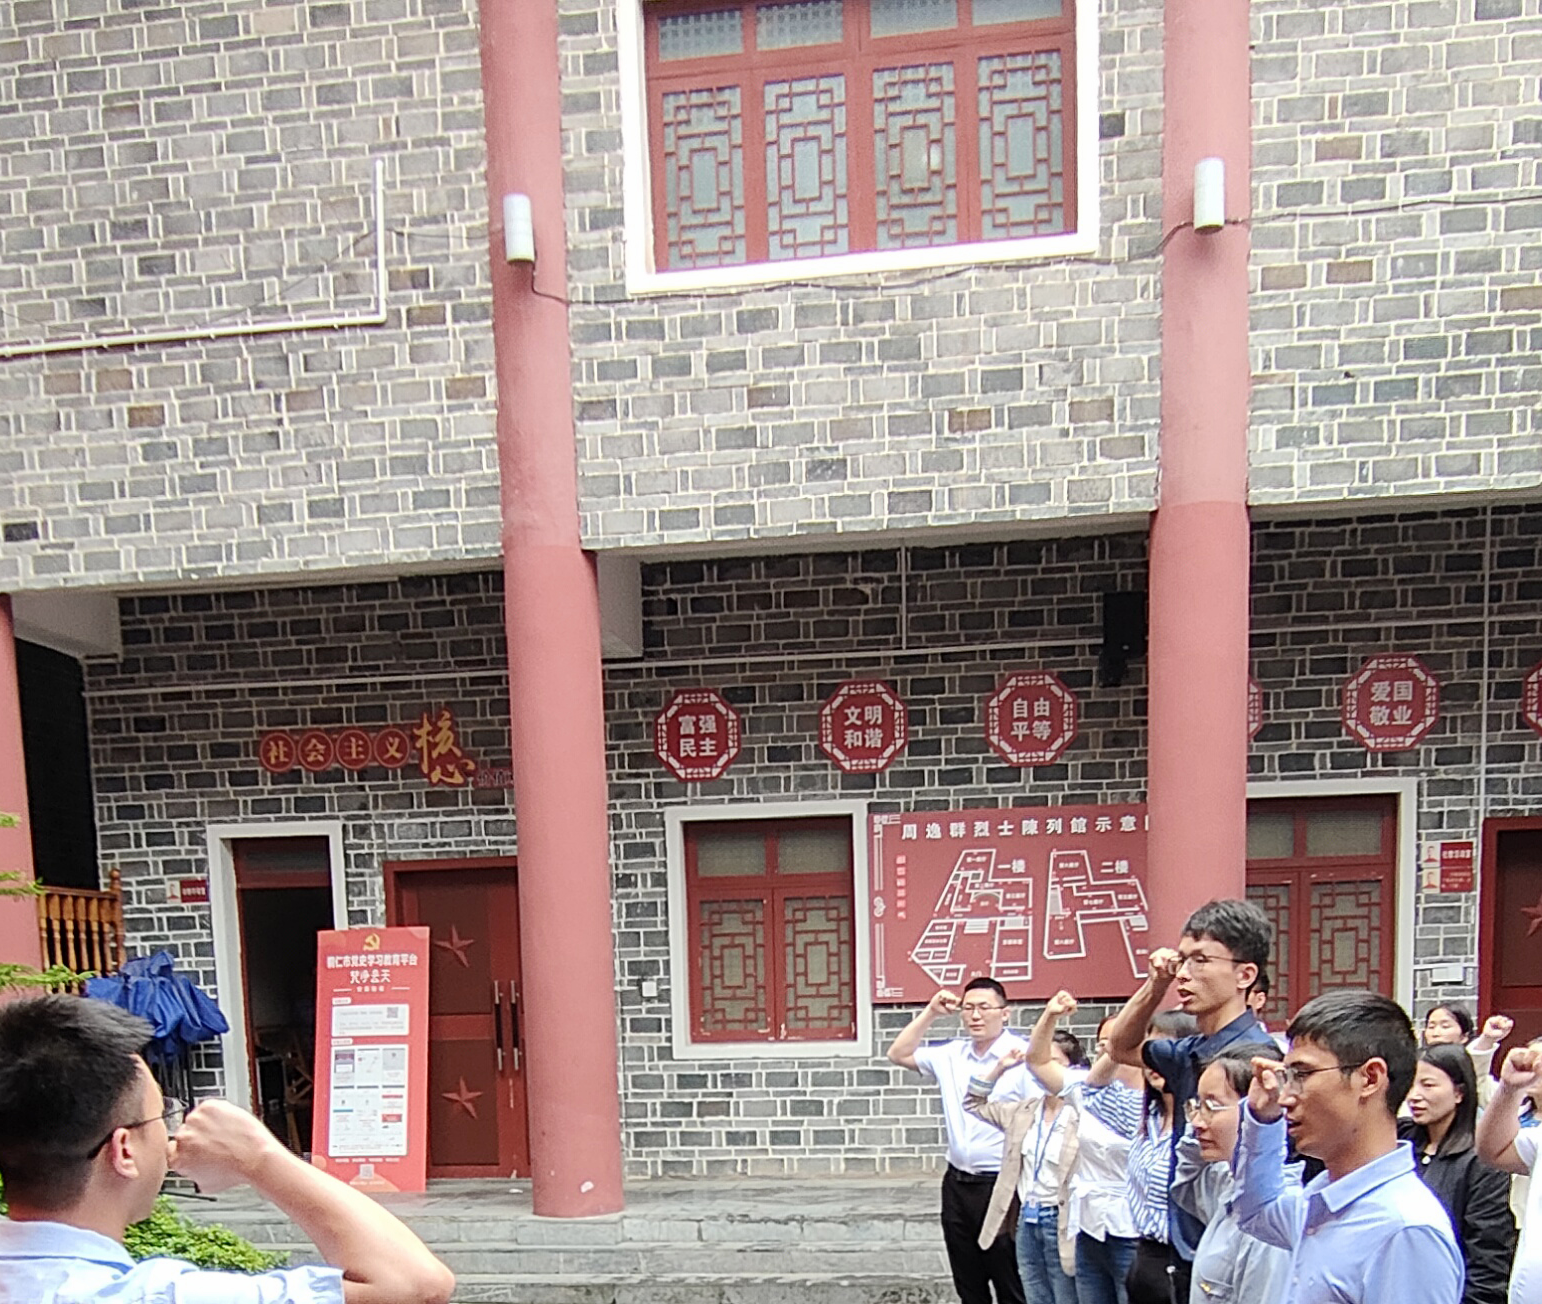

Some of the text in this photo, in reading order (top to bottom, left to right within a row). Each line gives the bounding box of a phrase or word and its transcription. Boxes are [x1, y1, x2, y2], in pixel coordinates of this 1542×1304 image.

[1370, 680, 1414, 702] 爱国
[844, 704, 884, 725] 文明
[1011, 696, 1052, 719] 自由
[1369, 705, 1413, 726] 敬业
[678, 714, 718, 735] 富强
[1010, 720, 1053, 742] 平等
[678, 736, 719, 757] 民主
[843, 728, 884, 749] 和谐
[901, 815, 1149, 840] 周逸群烈士陳列館示意
